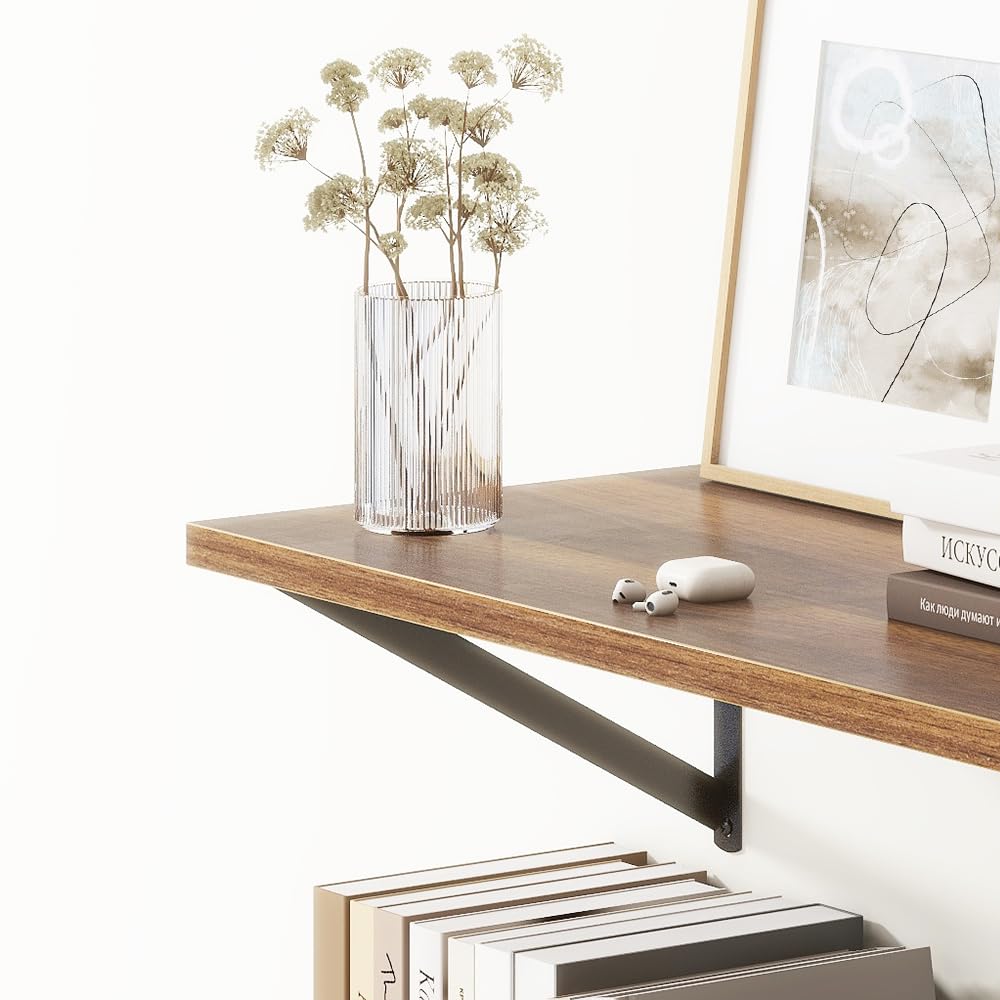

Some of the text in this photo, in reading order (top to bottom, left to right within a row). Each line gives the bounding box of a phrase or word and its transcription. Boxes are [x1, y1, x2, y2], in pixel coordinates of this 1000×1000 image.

[920, 597, 936, 611] Как
[936, 602, 960, 620] люди
[960, 607, 994, 626] думают
